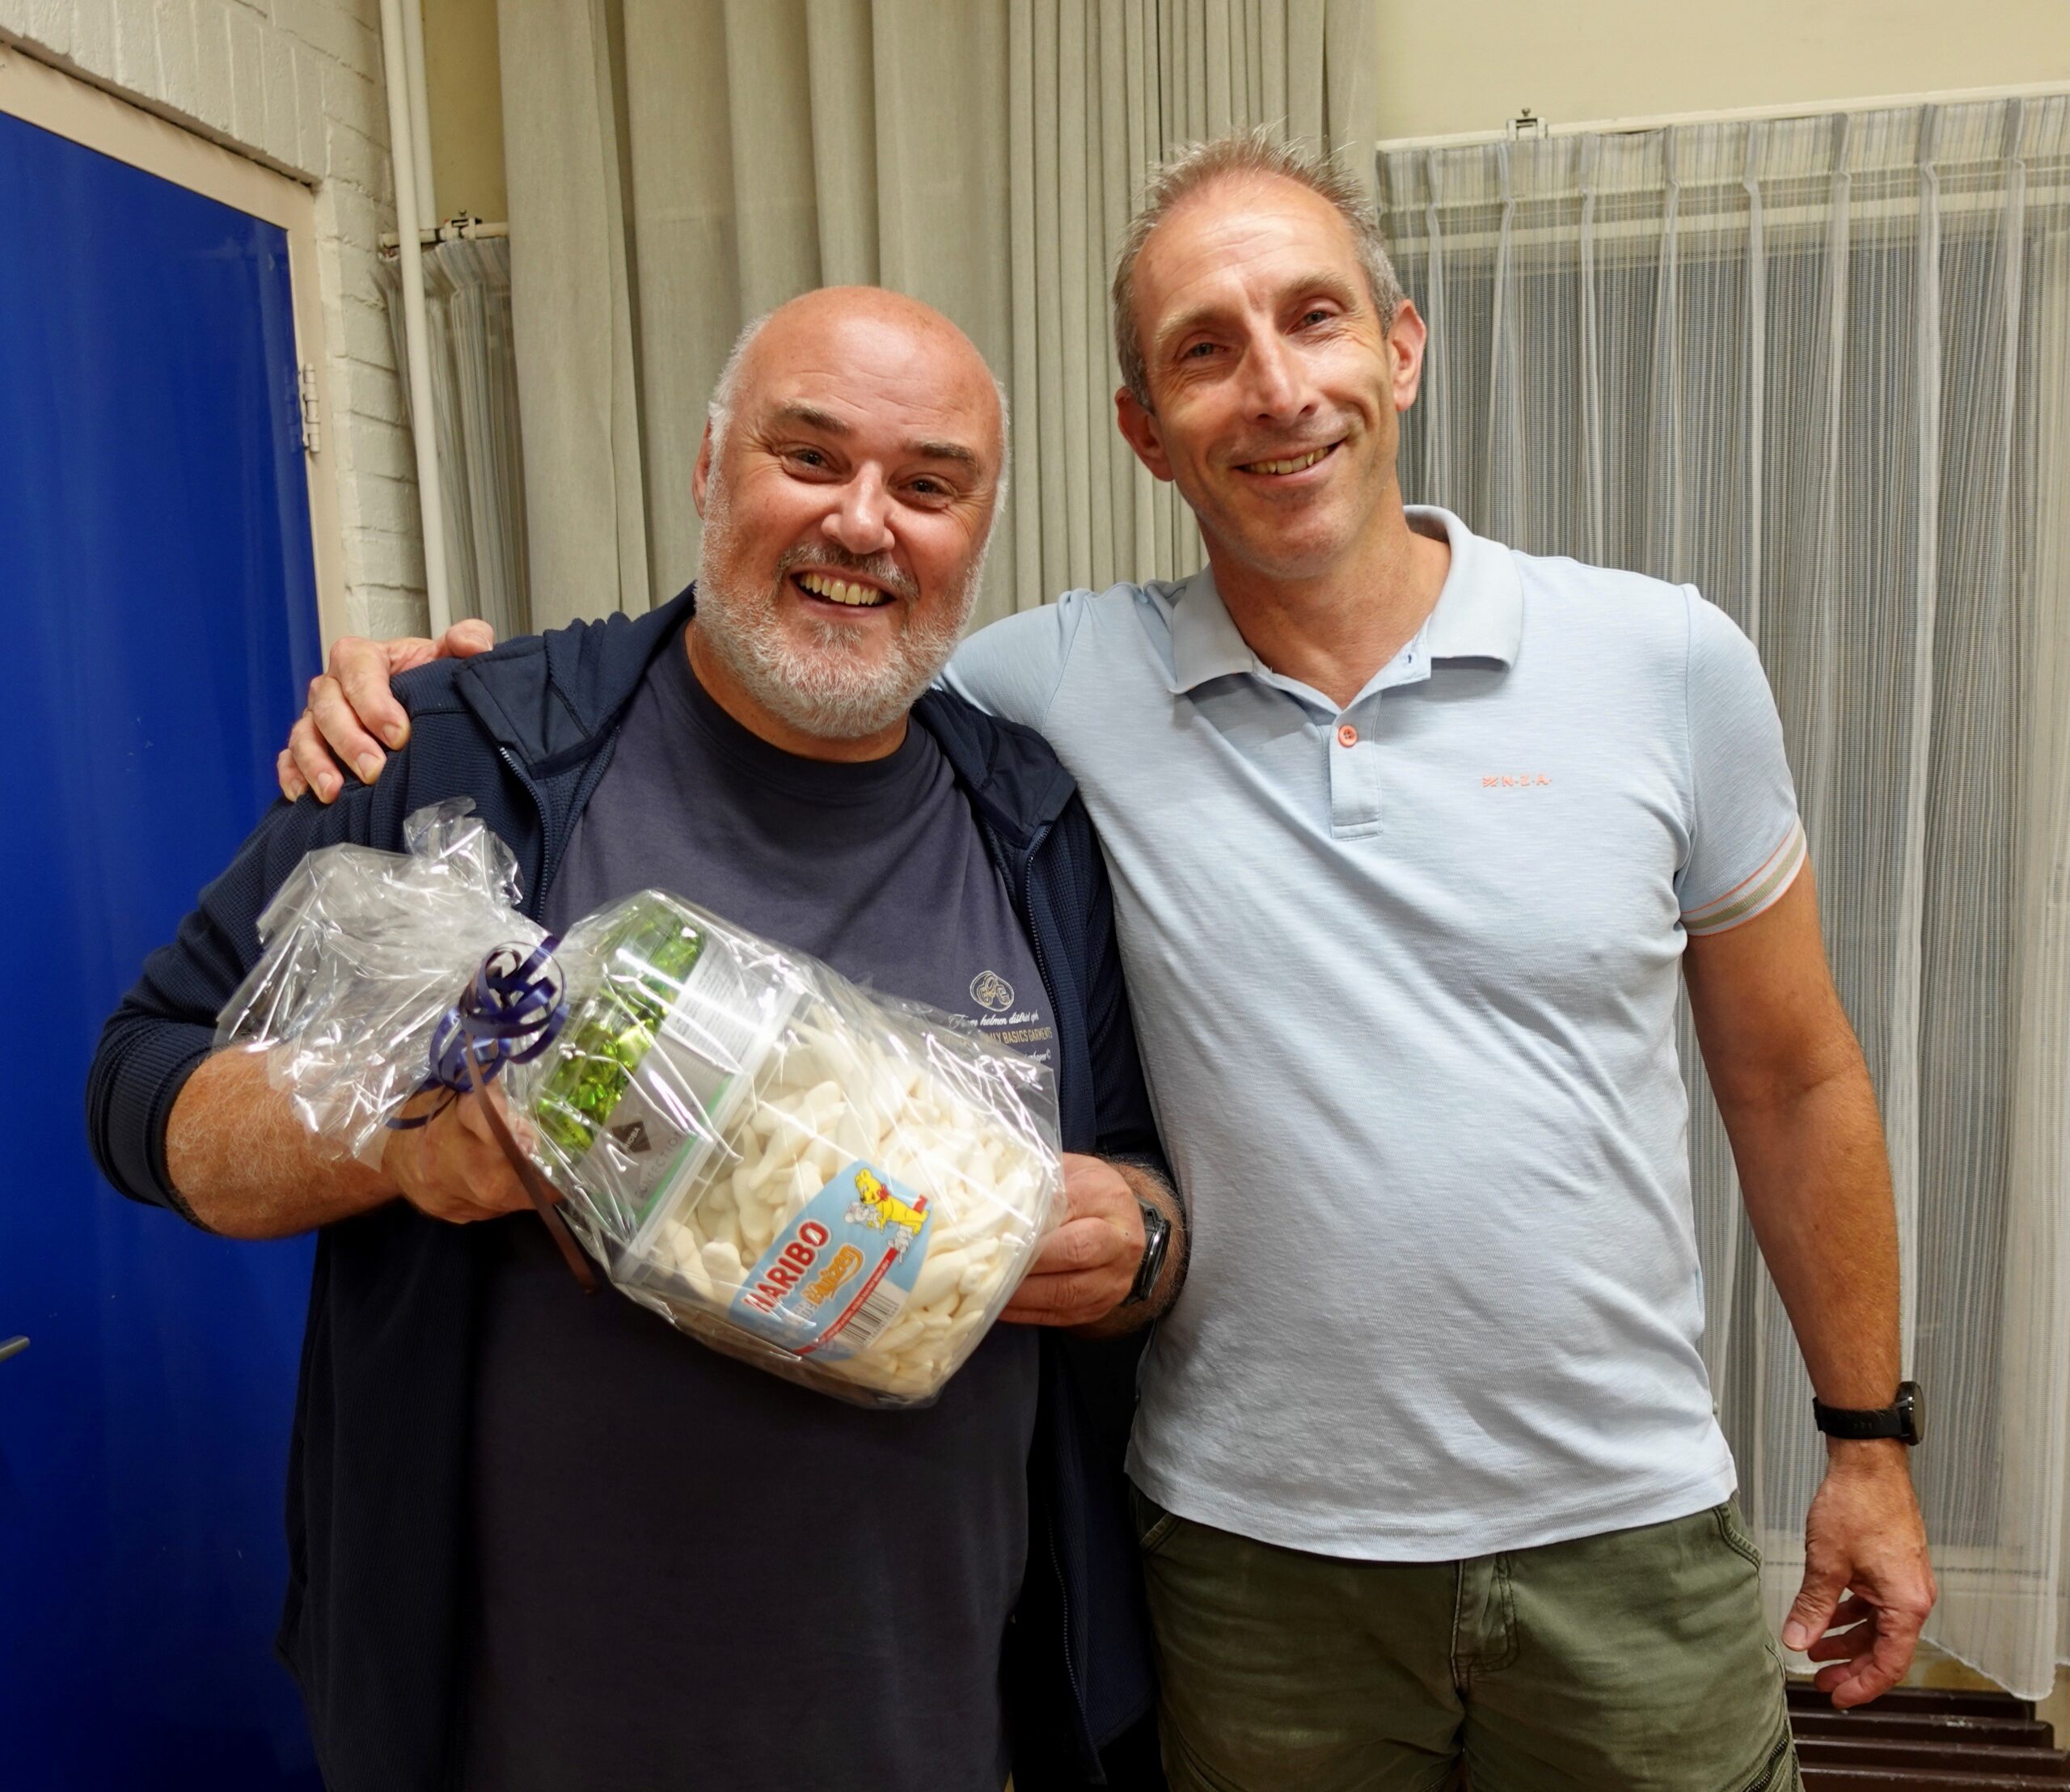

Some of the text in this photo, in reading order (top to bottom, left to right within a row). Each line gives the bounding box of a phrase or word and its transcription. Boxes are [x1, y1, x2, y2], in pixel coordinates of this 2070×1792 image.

[1002, 1029, 1029, 1044] BASICS
[1028, 1026, 1053, 1042] GARMENTS
[741, 1220, 830, 1313] HARIBO
